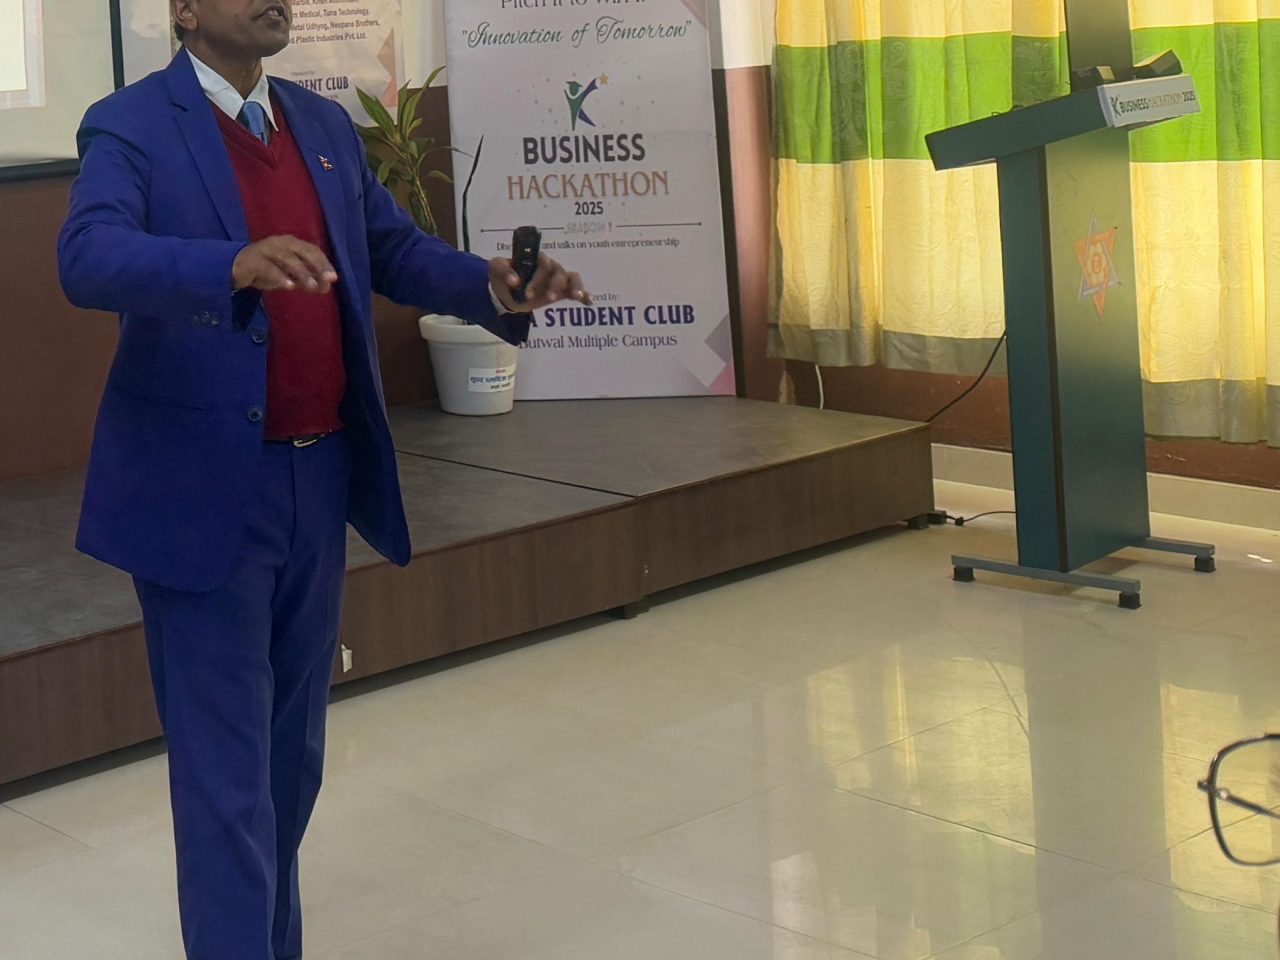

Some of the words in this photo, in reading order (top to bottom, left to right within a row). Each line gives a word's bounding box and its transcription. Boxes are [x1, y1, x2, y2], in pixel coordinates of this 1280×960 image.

[571, 23, 589, 48] of
[325, 76, 349, 91] CLUB
[523, 133, 646, 165] BUSINESS
[507, 171, 669, 200] HACKATHON
[574, 201, 604, 215] 2025
[541, 240, 556, 249] and
[576, 241, 587, 249] on
[588, 240, 609, 250] youth
[611, 237, 679, 249] entrepreneurship
[545, 306, 636, 327] STUDENT
[644, 304, 695, 325] CLUB
[568, 334, 618, 350] Multiple
[622, 334, 678, 349] Campus
